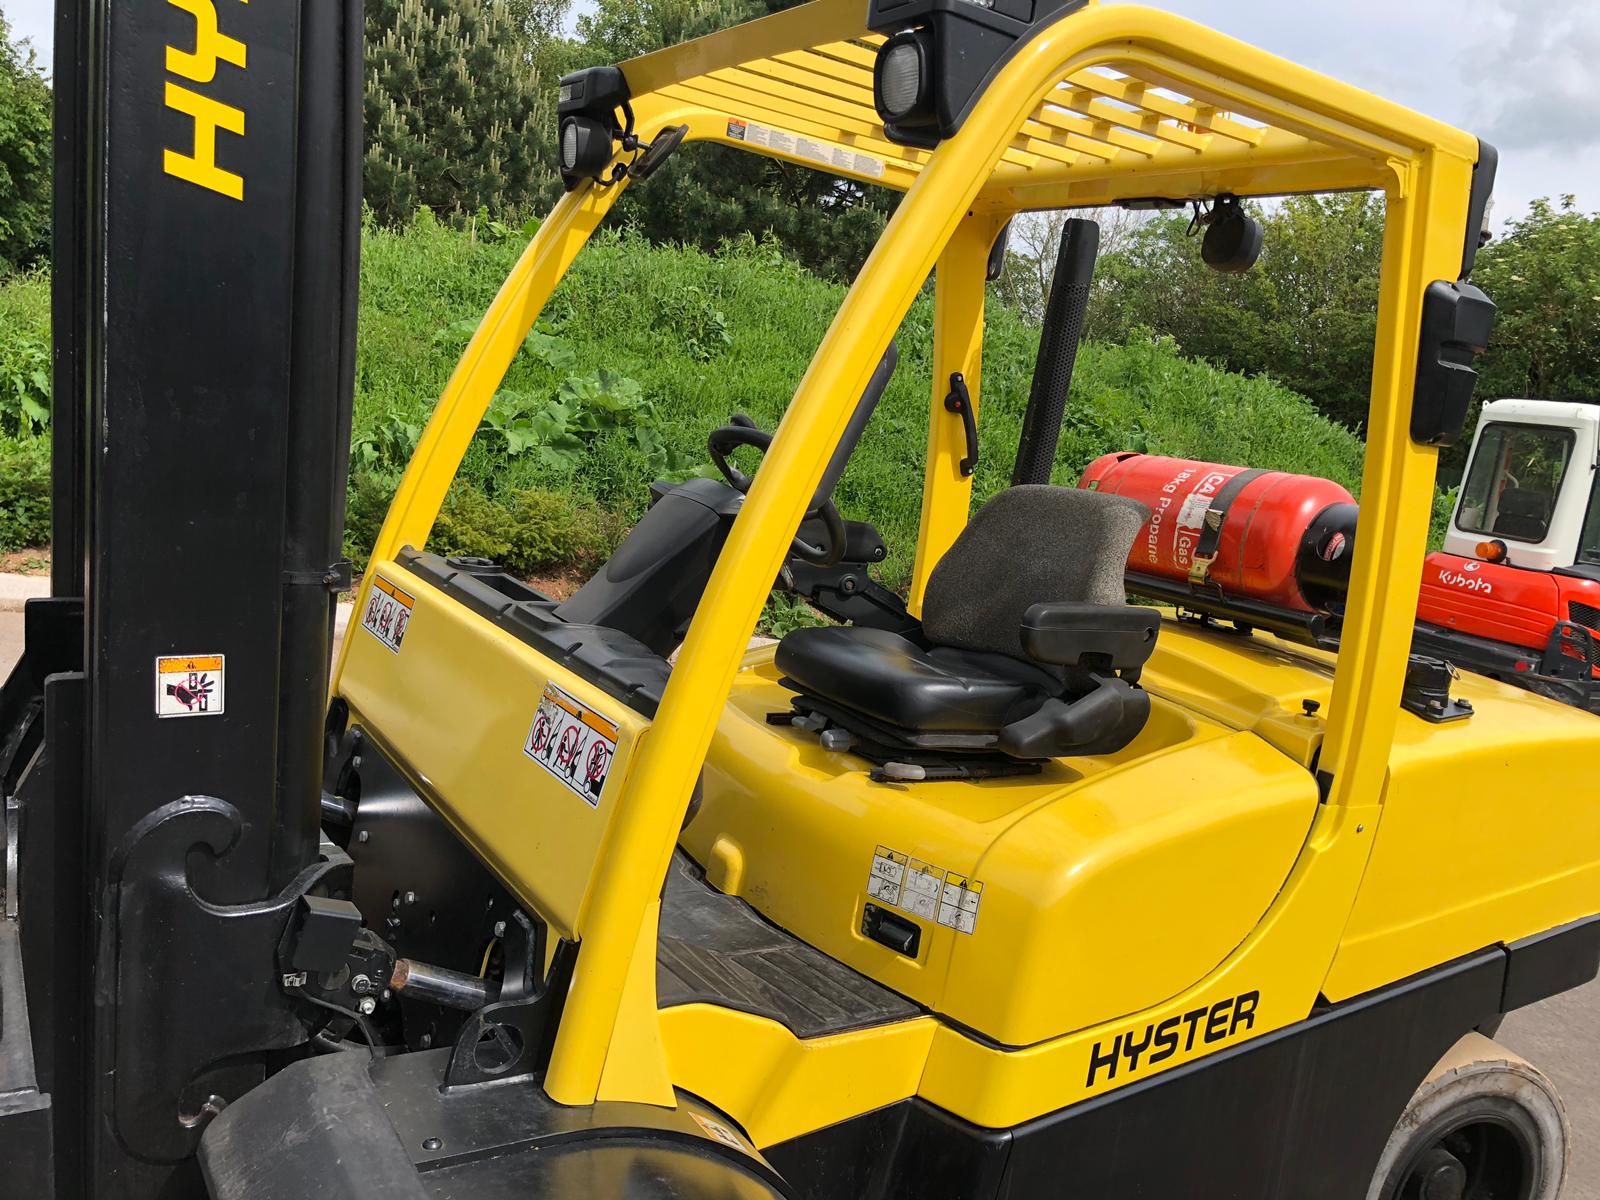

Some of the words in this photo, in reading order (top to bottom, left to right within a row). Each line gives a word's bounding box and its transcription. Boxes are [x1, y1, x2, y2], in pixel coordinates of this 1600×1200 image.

[164, 0, 249, 201] HY
[1162, 469, 1197, 494] 18kg
[1148, 497, 1172, 564] Propane
[1178, 536, 1192, 565] Gas
[1439, 569, 1492, 594] Kubota
[1086, 990, 1260, 1088] HYSTER
